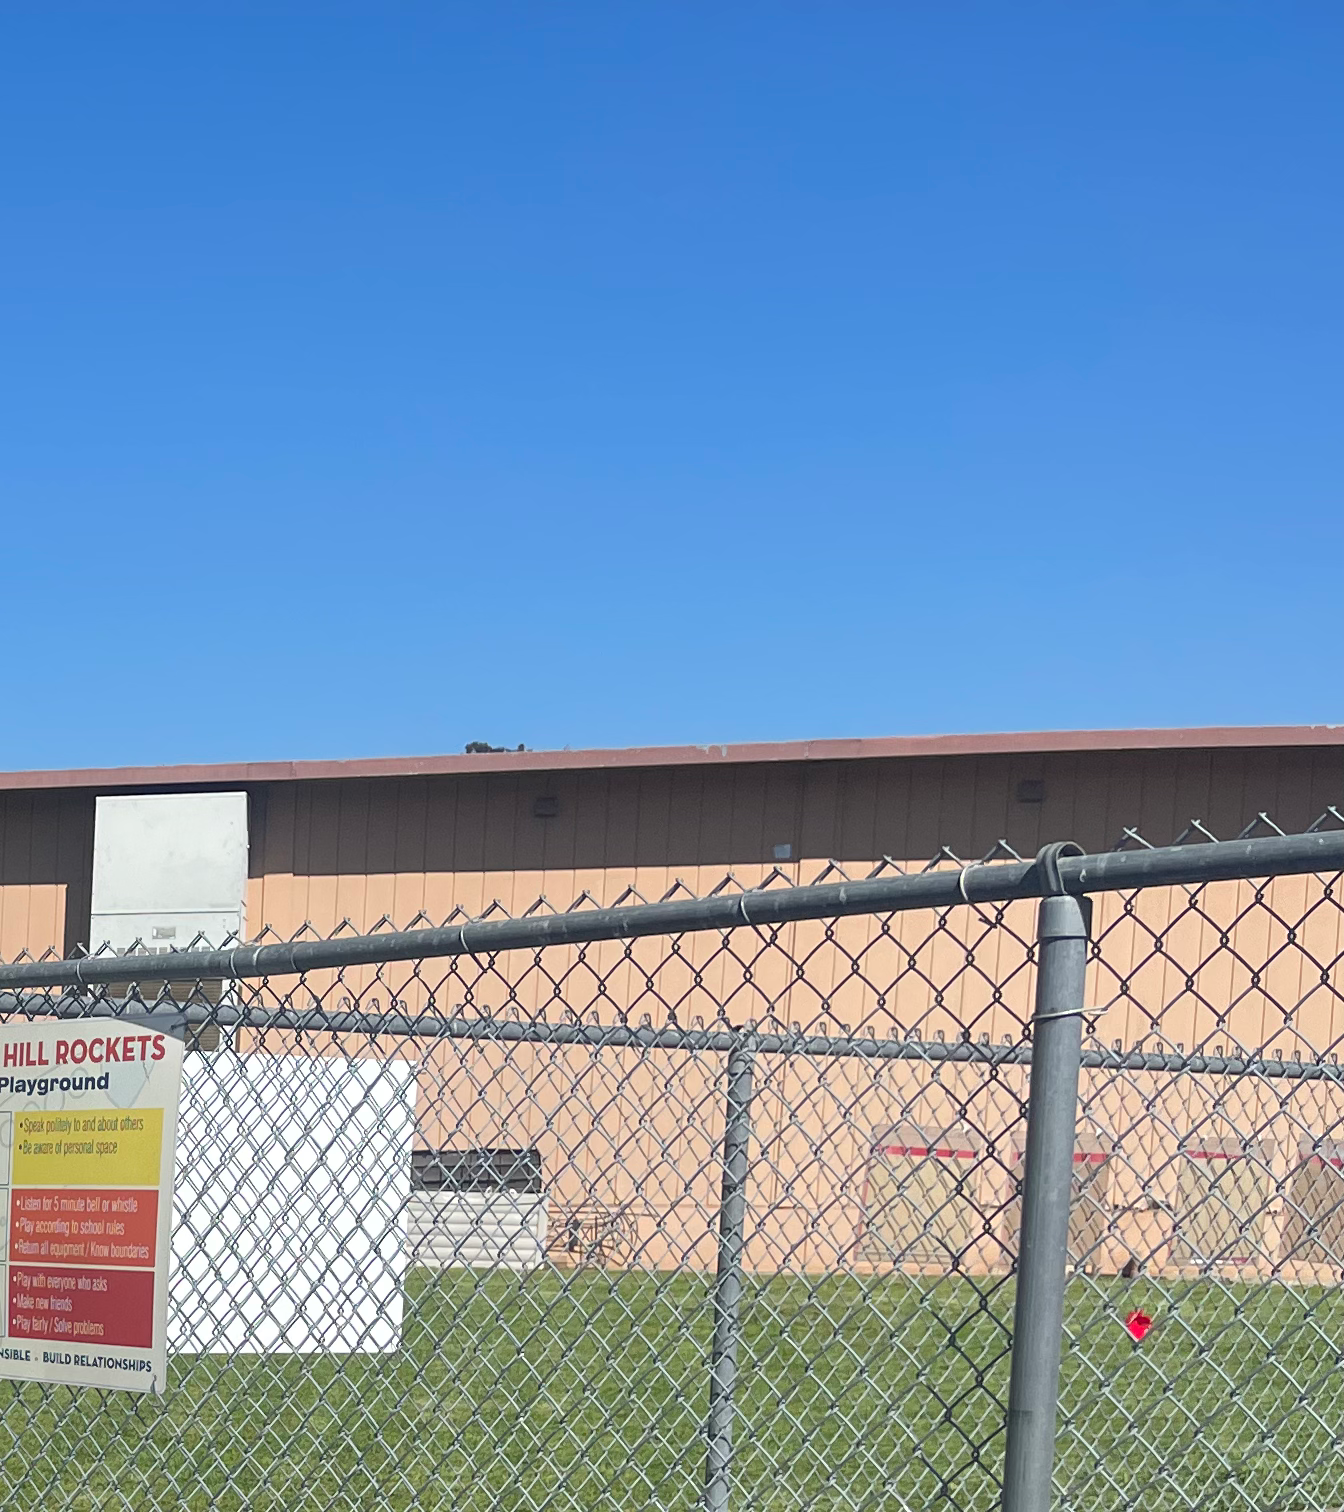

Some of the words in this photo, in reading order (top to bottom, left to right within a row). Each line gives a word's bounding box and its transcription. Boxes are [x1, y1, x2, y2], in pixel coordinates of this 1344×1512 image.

[3, 1041, 49, 1068] HILL
[55, 1034, 166, 1065] ROCKETS
[23, 1117, 45, 1135] Speak
[45, 1117, 72, 1135] politely
[73, 1117, 81, 1132] to
[82, 1116, 96, 1132] and
[97, 1116, 120, 1132] about
[120, 1115, 144, 1132] others
[22, 1139, 32, 1155] Be
[55, 1139, 63, 1155] of
[63, 1139, 94, 1156] personal
[95, 1140, 118, 1156] space
[20, 1196, 41, 1211] Listen
[42, 1195, 53, 1211] for
[53, 1196, 59, 1211] 5
[60, 1196, 85, 1212] minute
[86, 1196, 101, 1212] bell
[102, 1199, 110, 1213] or
[111, 1196, 138, 1213] whistle
[19, 1217, 34, 1236] Play
[35, 1218, 70, 1237] according
[71, 1219, 79, 1234] to
[79, 1219, 105, 1235] school
[105, 1219, 125, 1236] rules
[40, 1240, 49, 1256] all
[50, 1241, 85, 1258] equipment
[90, 1241, 110, 1257] Know
[110, 1242, 149, 1259] boundaries
[16, 1271, 32, 1291] Play
[32, 1273, 46, 1289] with
[47, 1275, 77, 1292] everyone
[77, 1275, 92, 1291] who
[92, 1276, 108, 1292] asks
[16, 1293, 34, 1309] Make
[35, 1296, 49, 1310] new
[50, 1295, 73, 1312] friends
[16, 1314, 31, 1334] Play
[32, 1316, 49, 1335] fairly
[53, 1316, 72, 1334] Solve
[73, 1319, 105, 1337] problems
[42, 1351, 72, 1365] BUILD
[73, 1354, 152, 1373] RELATIONSHIPS
